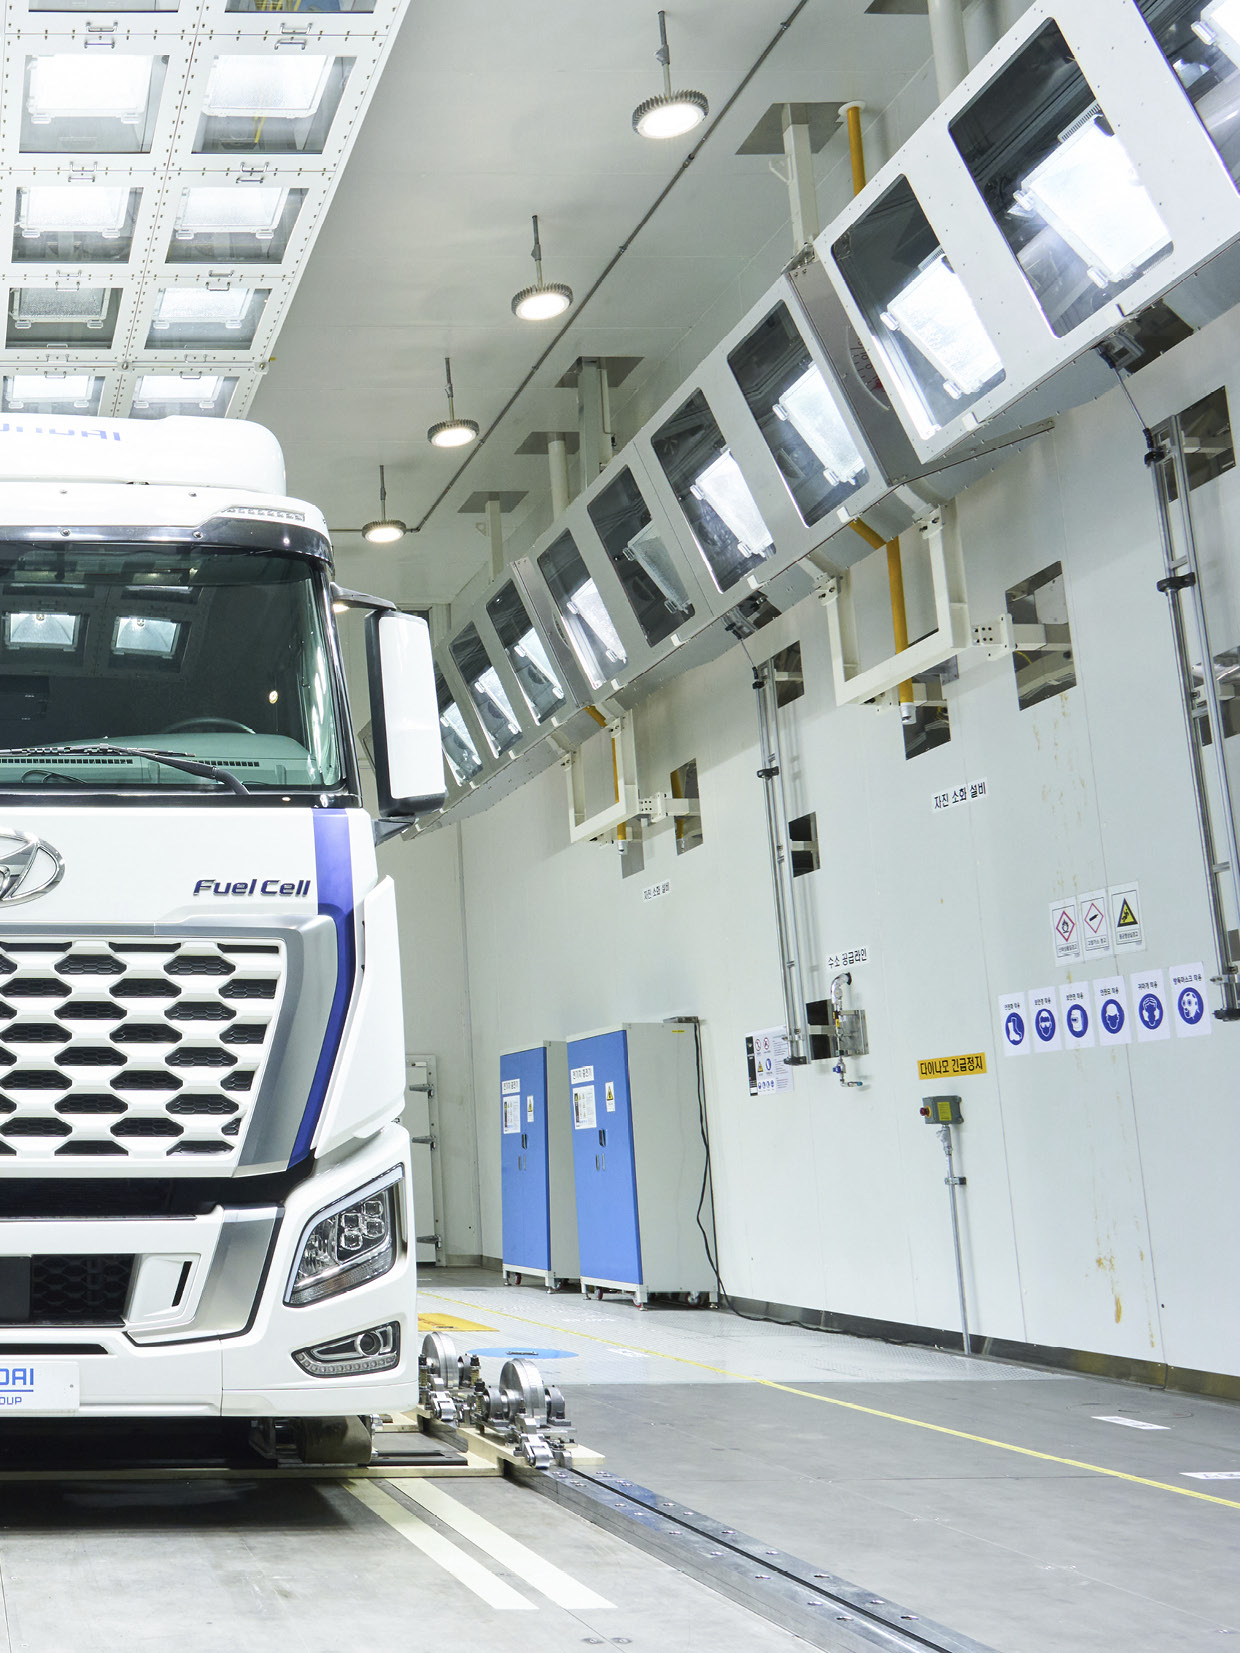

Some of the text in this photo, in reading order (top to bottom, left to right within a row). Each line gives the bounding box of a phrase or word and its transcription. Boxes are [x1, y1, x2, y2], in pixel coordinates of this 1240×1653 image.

[934, 782, 986, 809] 자진 소화 설비
[193, 878, 311, 897] Fuel Cell
[828, 948, 867, 968] 수소 공급라인
[920, 1055, 983, 1075] 다이나모 긴급정지
